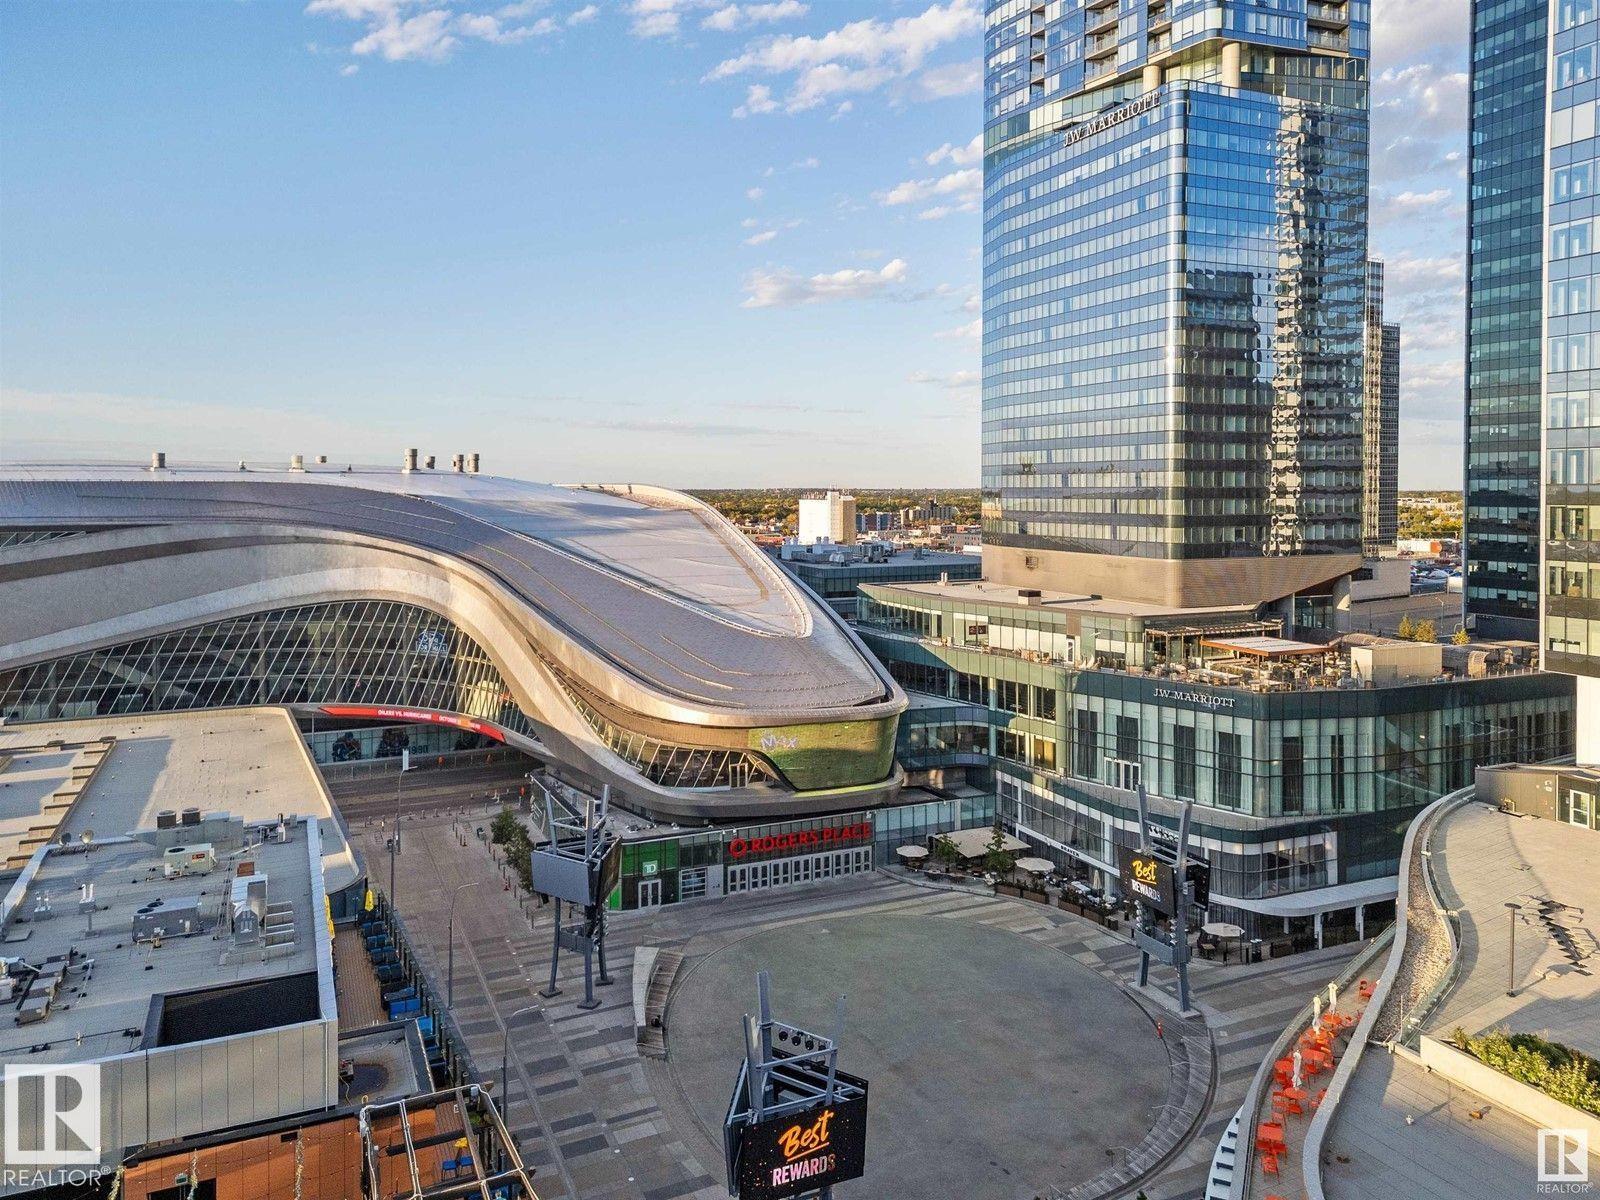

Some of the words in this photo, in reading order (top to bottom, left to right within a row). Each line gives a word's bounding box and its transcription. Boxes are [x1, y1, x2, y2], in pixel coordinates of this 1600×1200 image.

[1063, 127, 1082, 147] JW
[1086, 91, 1161, 136] MARRIOTT
[1153, 688, 1170, 698] JW
[1174, 691, 1235, 708] MARRIOTT
[751, 829, 818, 853] ROGERS
[822, 821, 872, 842] PLACE
[643, 863, 656, 873] TD
[1132, 860, 1157, 881] Best
[1131, 878, 1161, 902] REWARDS
[778, 1109, 834, 1157] Best
[772, 1153, 836, 1187] REWARDS
